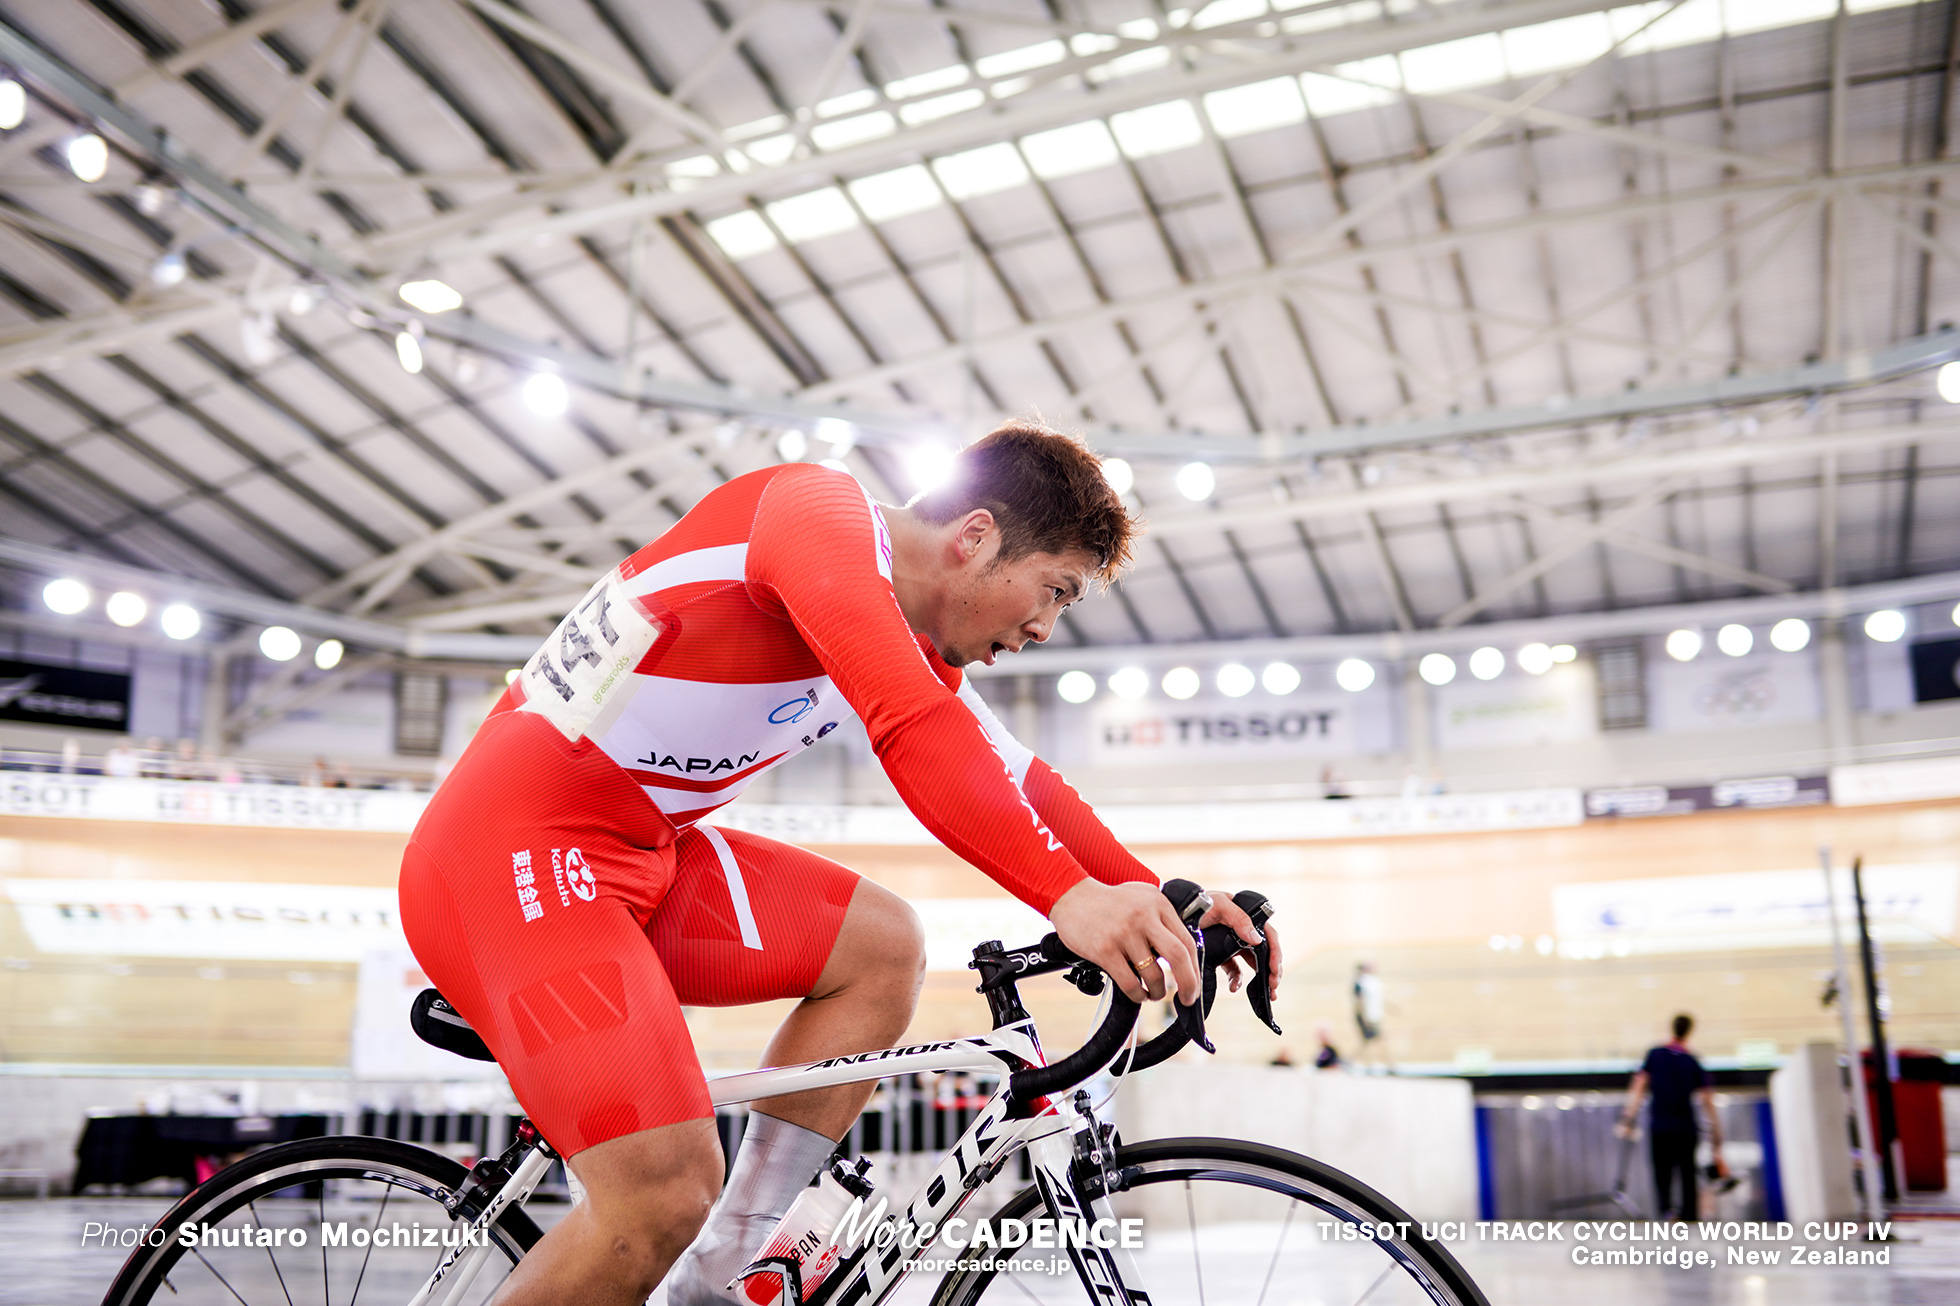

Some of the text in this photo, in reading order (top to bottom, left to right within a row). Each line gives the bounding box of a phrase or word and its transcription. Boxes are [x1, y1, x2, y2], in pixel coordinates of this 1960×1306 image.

[531, 583, 620, 702] 147
[592, 655, 630, 704] grassroots
[1173, 710, 1337, 743] TISSOT
[637, 750, 760, 775] JAPAN
[512, 849, 544, 923] 東港金属
[550, 848, 570, 907] Kabuto
[804, 1041, 957, 1072] ANCHOR
[427, 1194, 505, 1294] ANCOR
